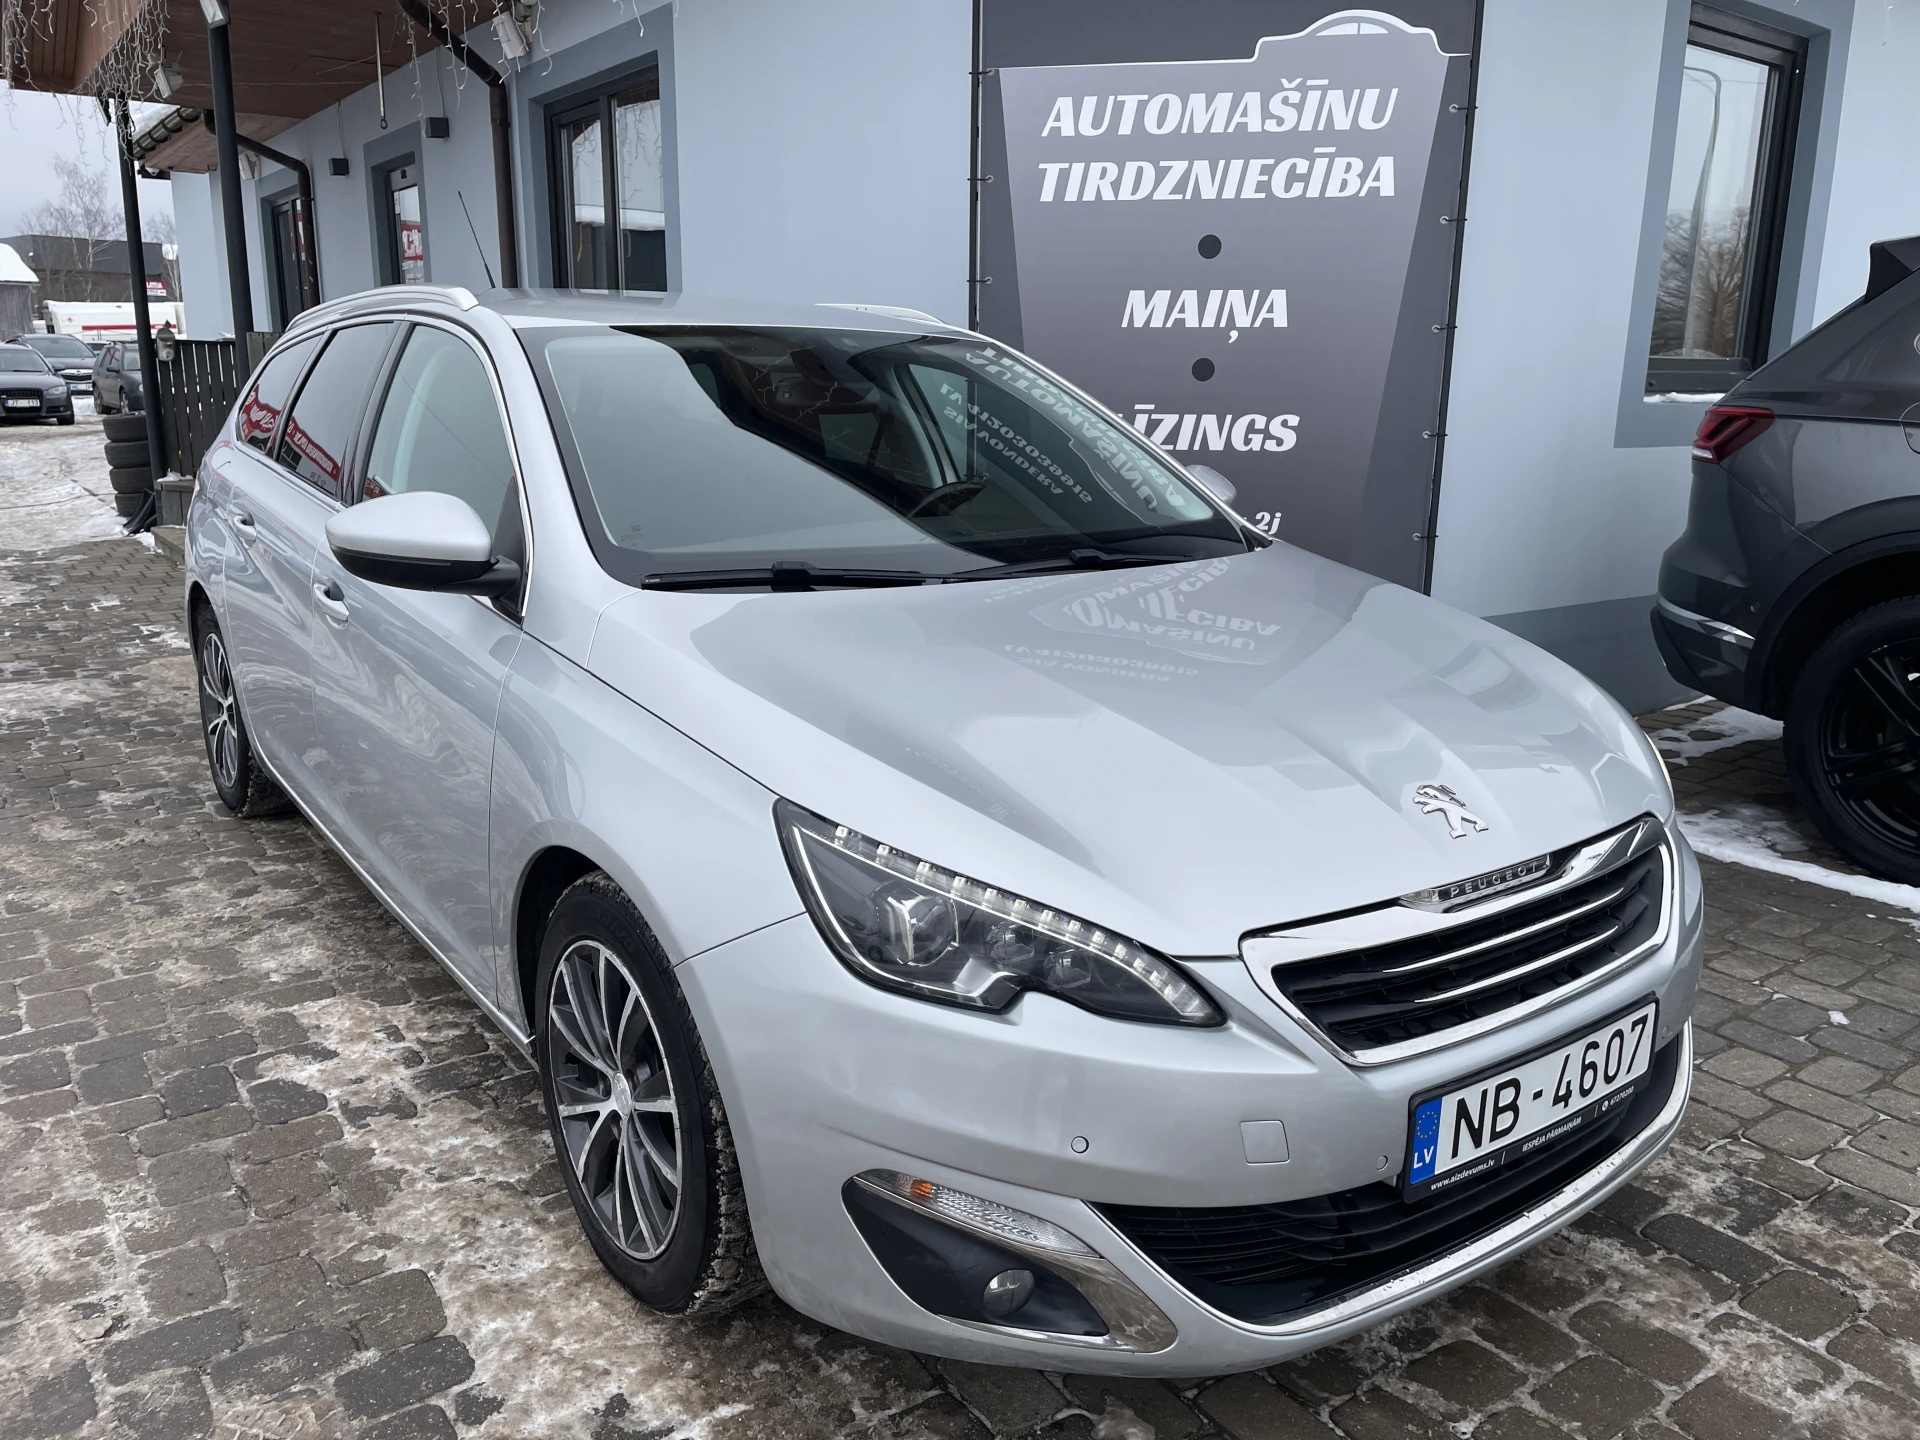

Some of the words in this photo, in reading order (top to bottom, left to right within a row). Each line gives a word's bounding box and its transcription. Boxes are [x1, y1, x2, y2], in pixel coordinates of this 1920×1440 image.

[1041, 78, 1398, 137] AUTOMAŠĪNU
[1038, 147, 1396, 202] TIRDZNIECĪBA
[1121, 289, 1288, 344] MAIŅA
[1117, 404, 1300, 451] ĪZINGS
[1450, 862, 1539, 897] PEUGEOT
[1451, 1013, 1649, 1159] NB-4607
[1413, 1145, 1435, 1169] LV
[1430, 1158, 1495, 1190] www.aizdevums.lv
